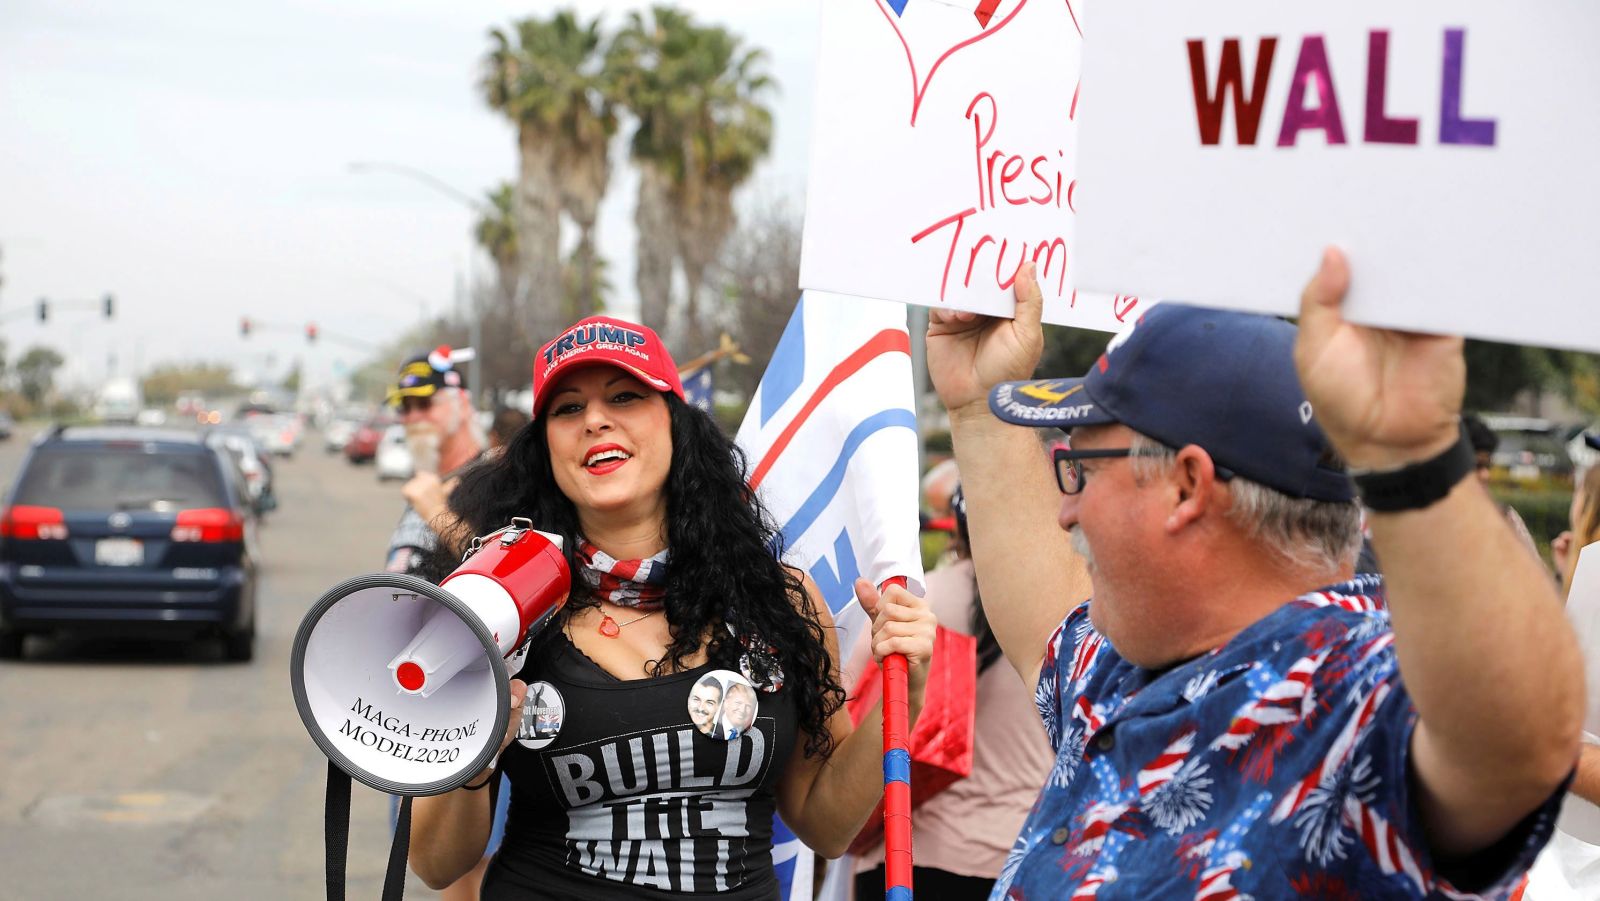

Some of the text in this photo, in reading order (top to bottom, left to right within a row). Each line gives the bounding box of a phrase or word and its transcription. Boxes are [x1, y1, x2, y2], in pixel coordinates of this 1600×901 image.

[1186, 27, 1496, 147] WALL
[911, 207, 1077, 309] Trum
[543, 326, 646, 365] TRUMP
[543, 343, 649, 379] MAKE AMERICA GREAT AGAIN
[1003, 401, 1094, 420] PRESIDENT
[551, 726, 765, 808] BUILD
[602, 795, 723, 840] THE
